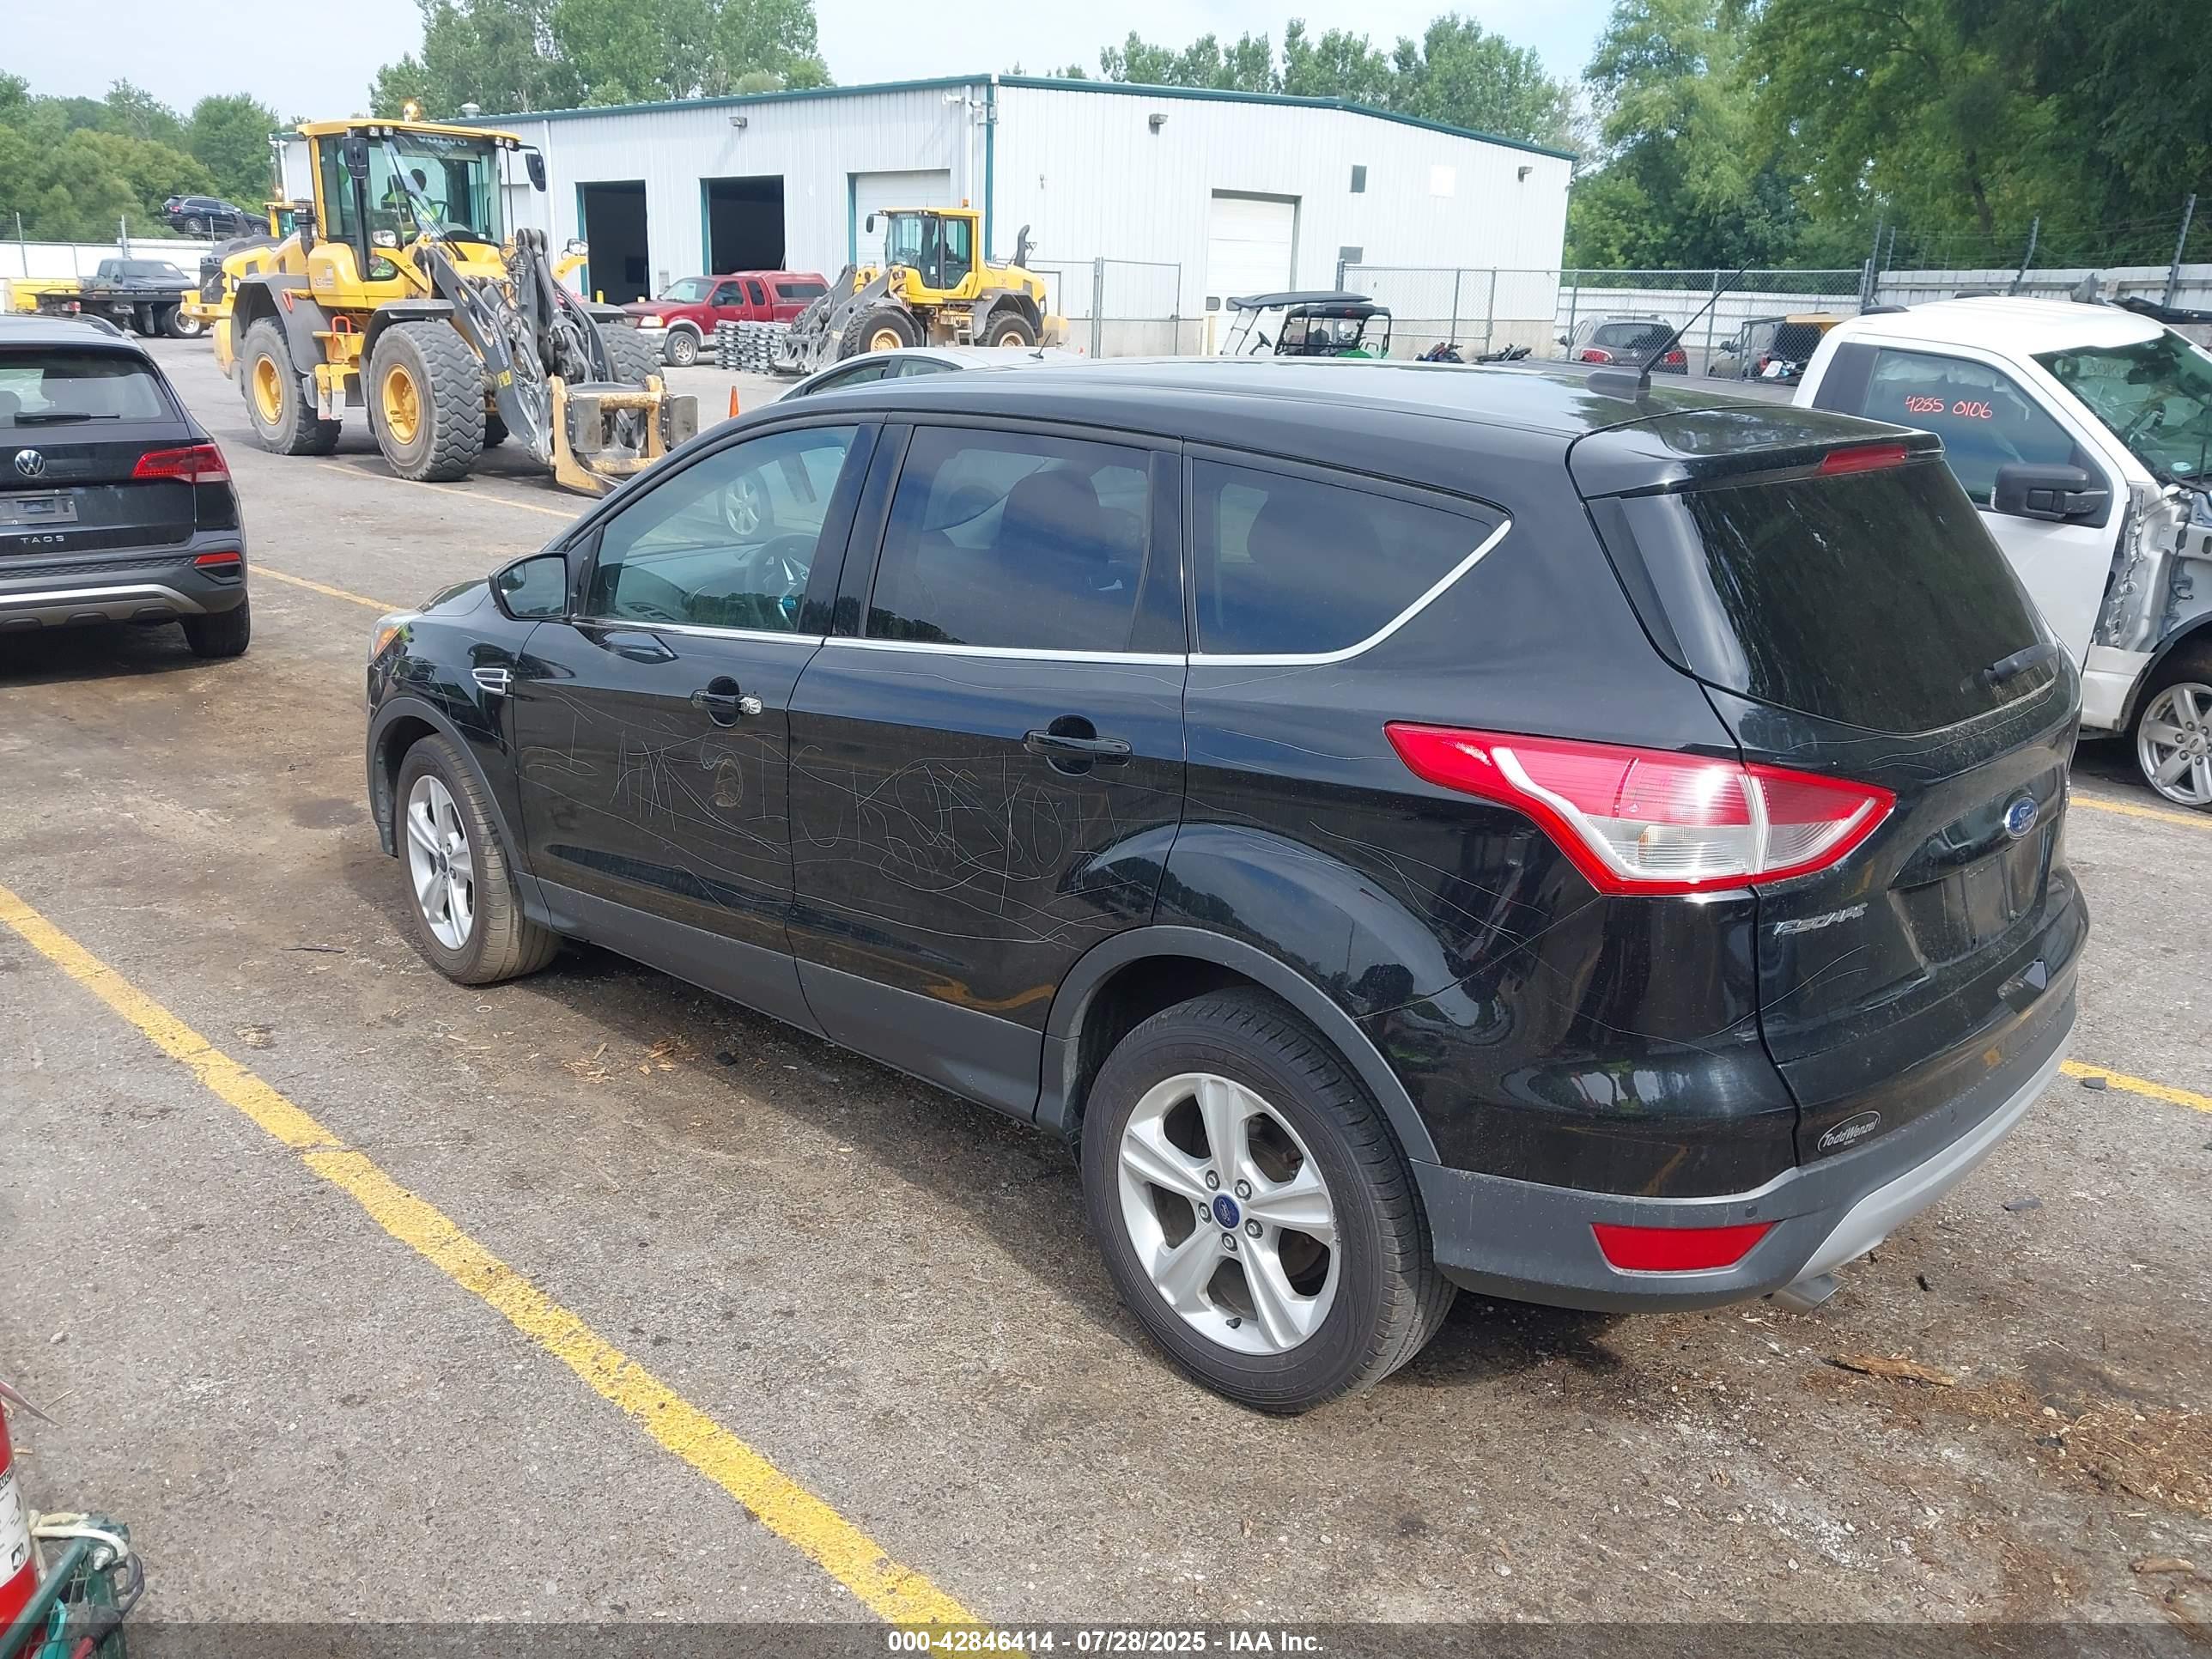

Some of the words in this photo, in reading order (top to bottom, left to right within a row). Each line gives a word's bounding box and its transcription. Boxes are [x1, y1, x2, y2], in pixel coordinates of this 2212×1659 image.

[1905, 395, 1945, 412] 4285
[1952, 400, 1993, 419] 0106
[20, 535, 64, 544] TAOS
